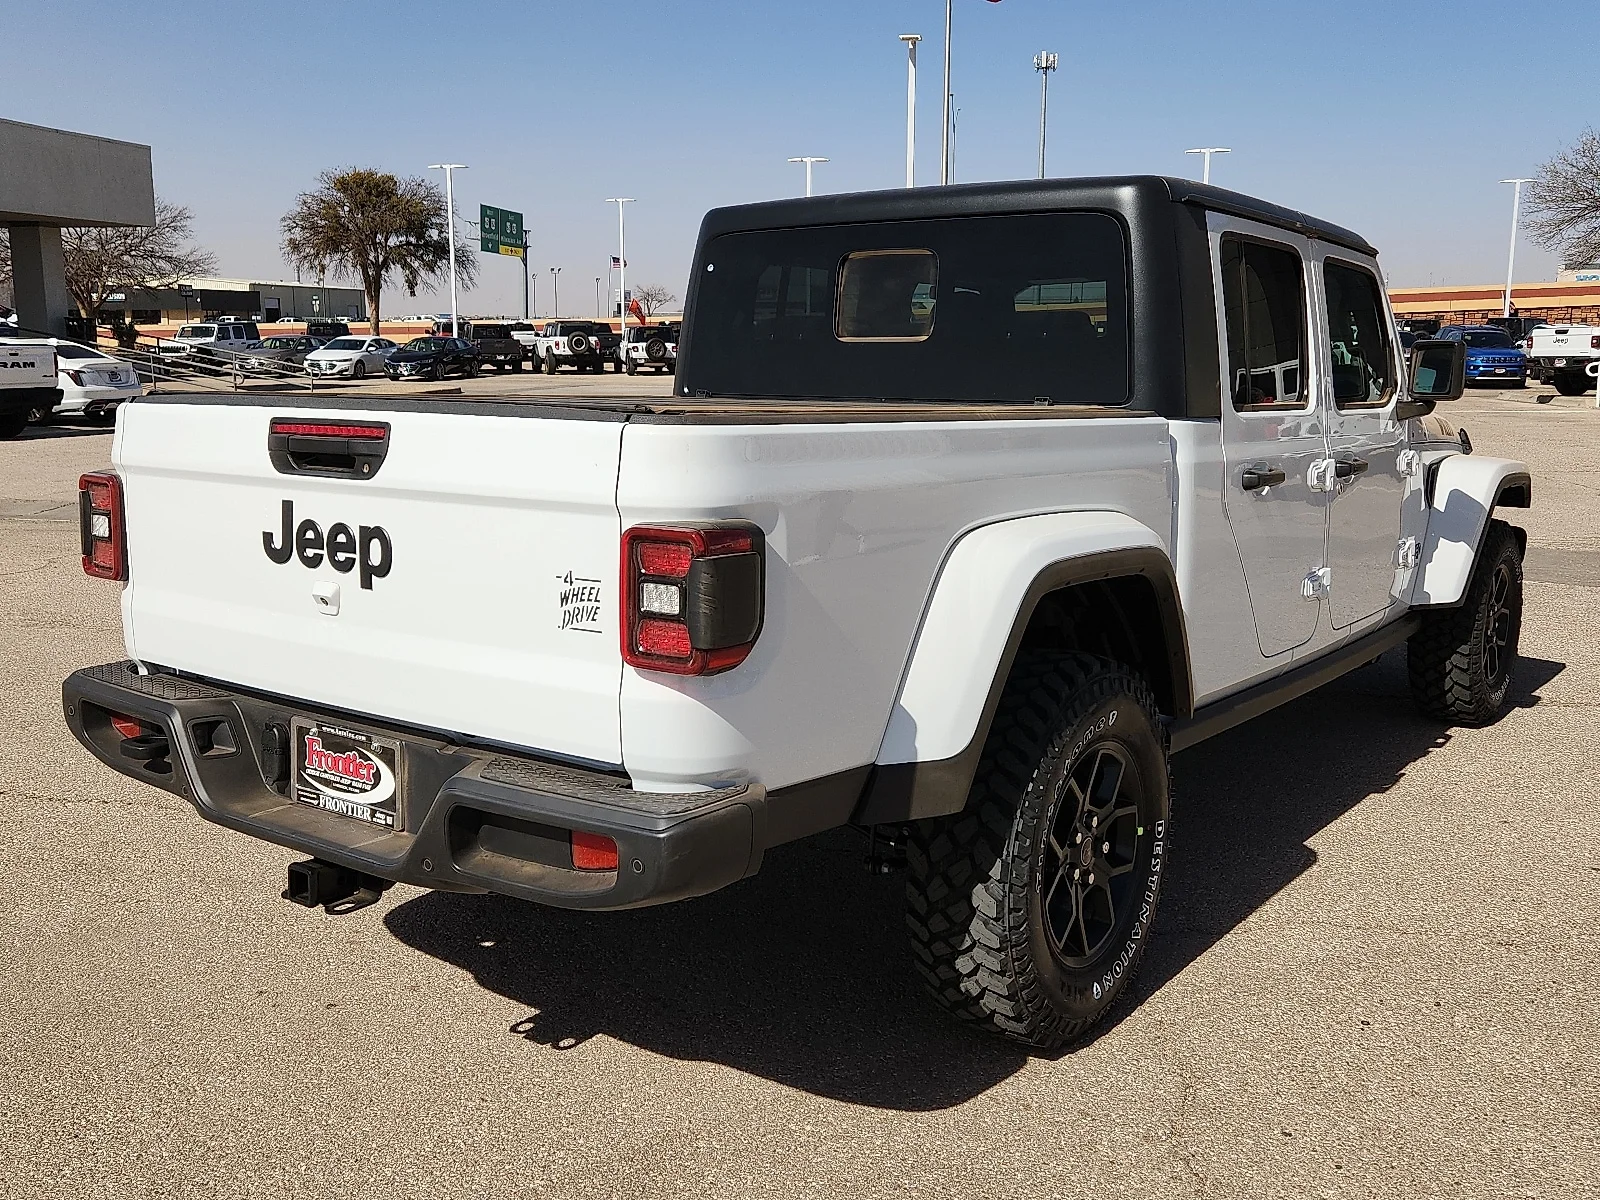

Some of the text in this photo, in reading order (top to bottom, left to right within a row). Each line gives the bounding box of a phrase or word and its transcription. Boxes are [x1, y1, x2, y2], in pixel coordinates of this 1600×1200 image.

[1553, 336, 1569, 345] Jeep
[0, 361, 36, 369] RAM
[262, 499, 393, 591] Jeep
[563, 570, 574, 587] 4
[560, 586, 601, 609] WHEEL
[561, 605, 601, 631] DRIVE
[304, 735, 377, 785] Frontier
[319, 794, 372, 822] FRONTIER
[1102, 819, 1166, 993] DESTINATION
